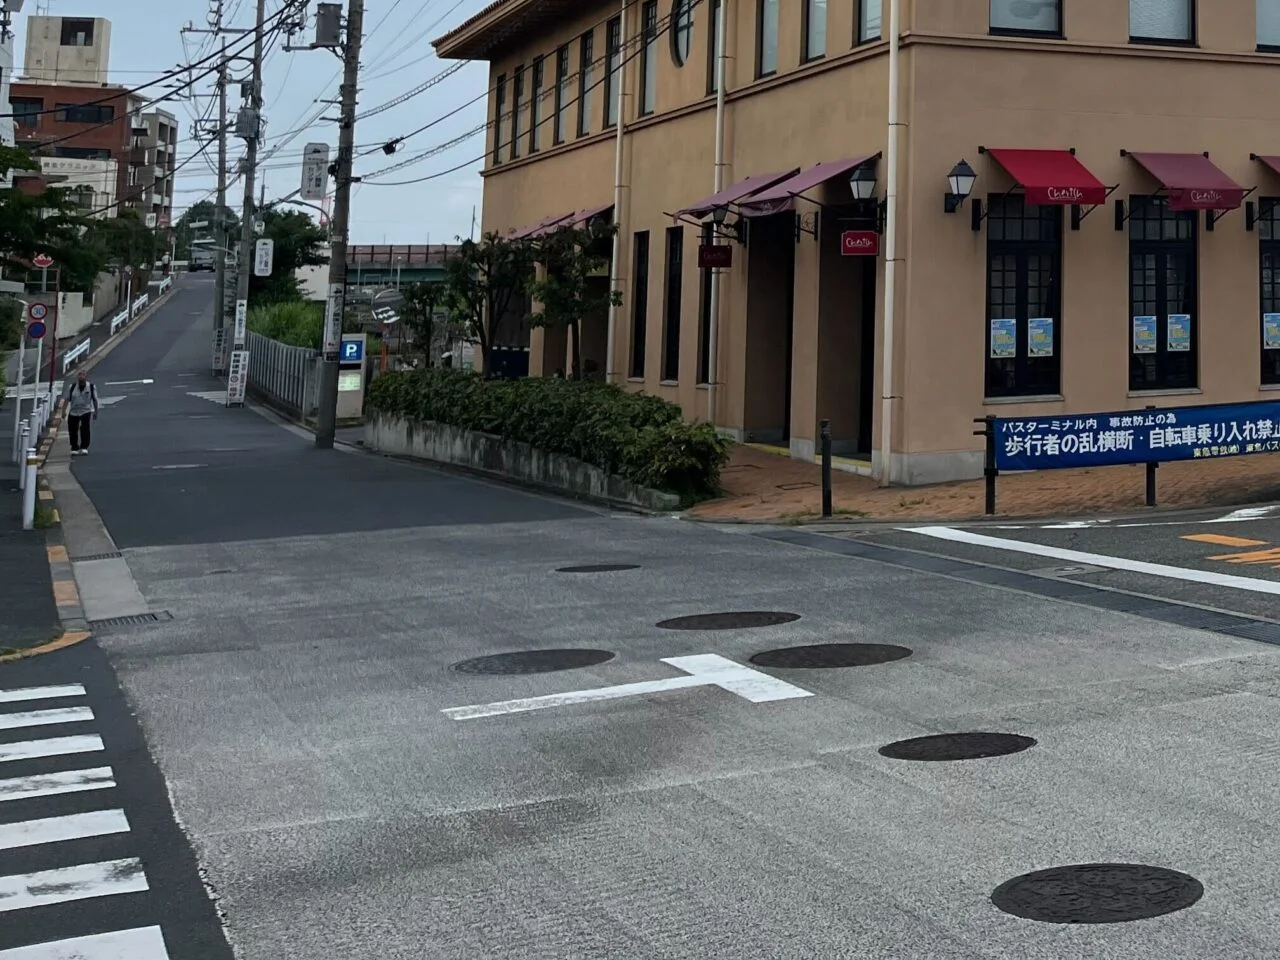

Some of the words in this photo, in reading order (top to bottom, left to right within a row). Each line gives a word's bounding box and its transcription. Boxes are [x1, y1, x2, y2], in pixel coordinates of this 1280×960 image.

[1047, 186, 1084, 201] Cherish
[346, 343, 357, 357] P
[1002, 419, 1098, 433] バスターミナル内
[1109, 412, 1176, 428] 事故防止の為
